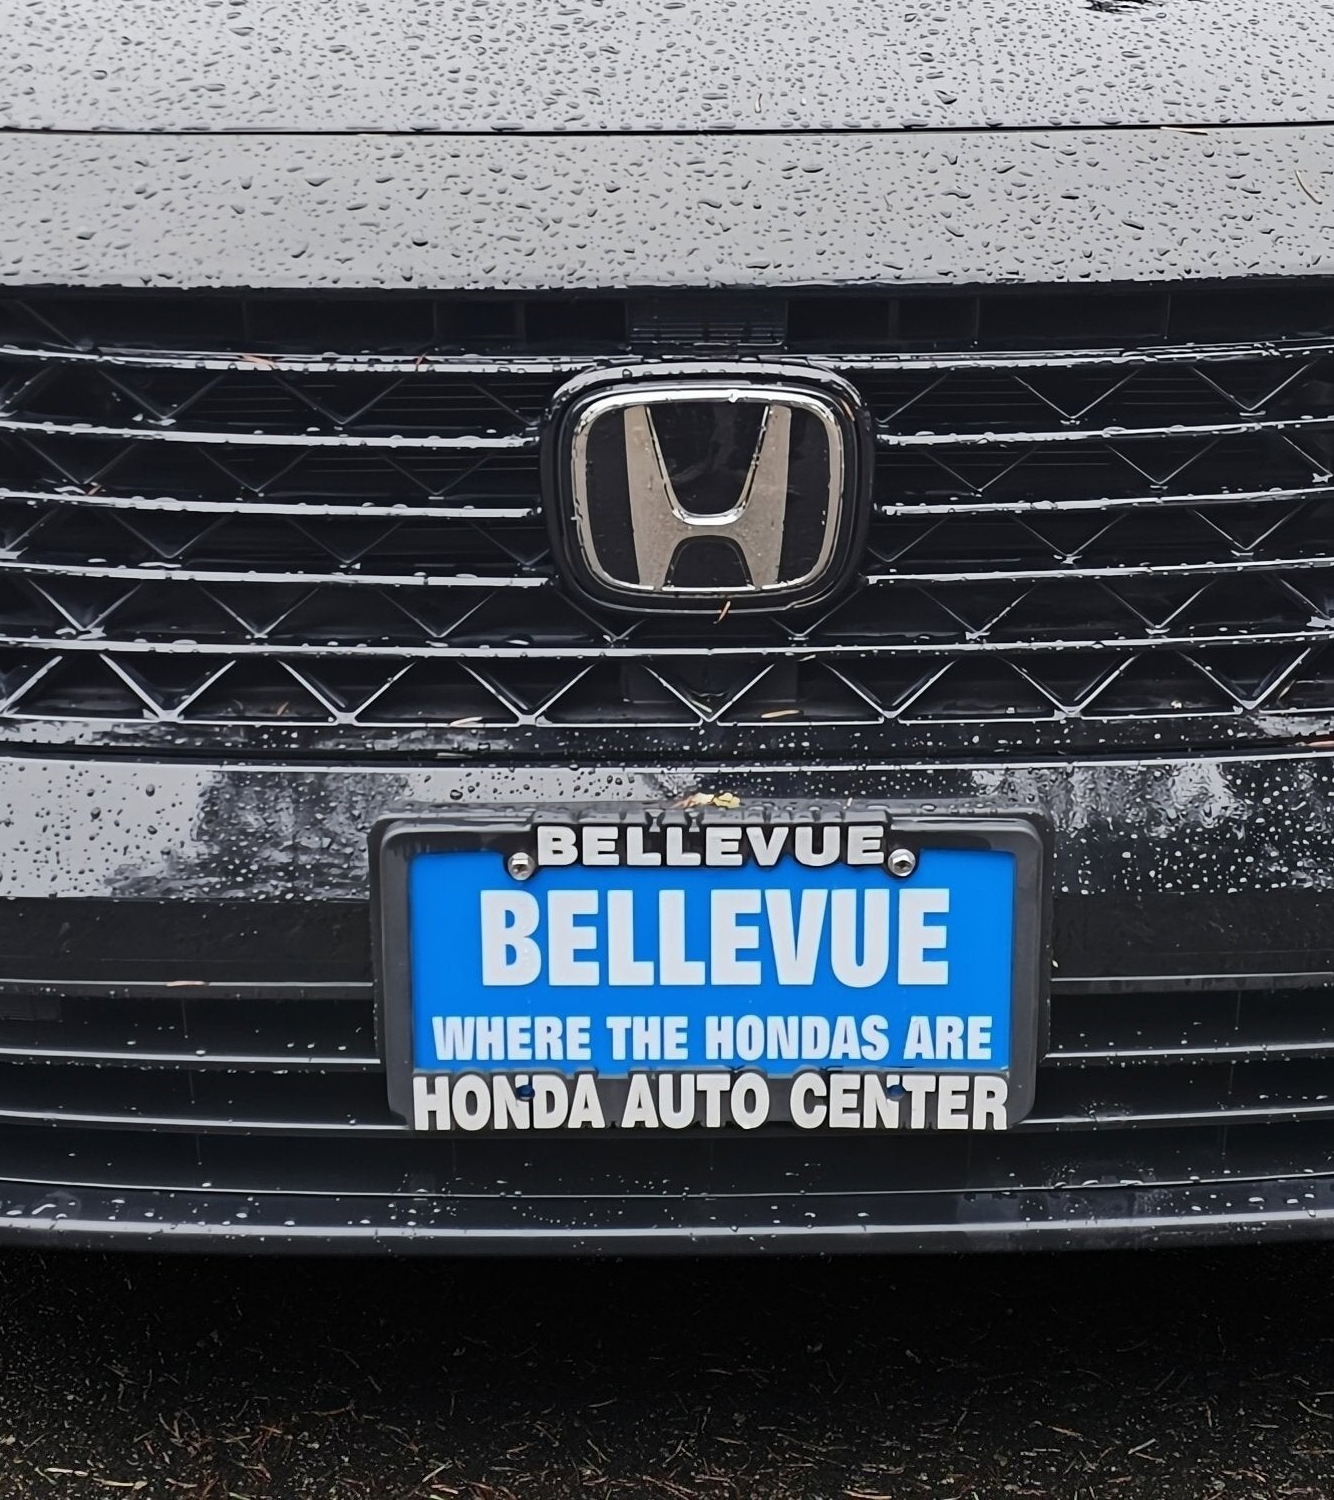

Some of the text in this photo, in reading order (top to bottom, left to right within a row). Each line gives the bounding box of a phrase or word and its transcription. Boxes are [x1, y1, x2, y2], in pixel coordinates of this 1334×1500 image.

[537, 826, 885, 867] BELLEVUE
[480, 889, 950, 988] BELLEVUE
[432, 1015, 992, 1060] WHERE THE HONDAS ARE
[413, 1073, 1008, 1131] HONDA AUTO CENTER
